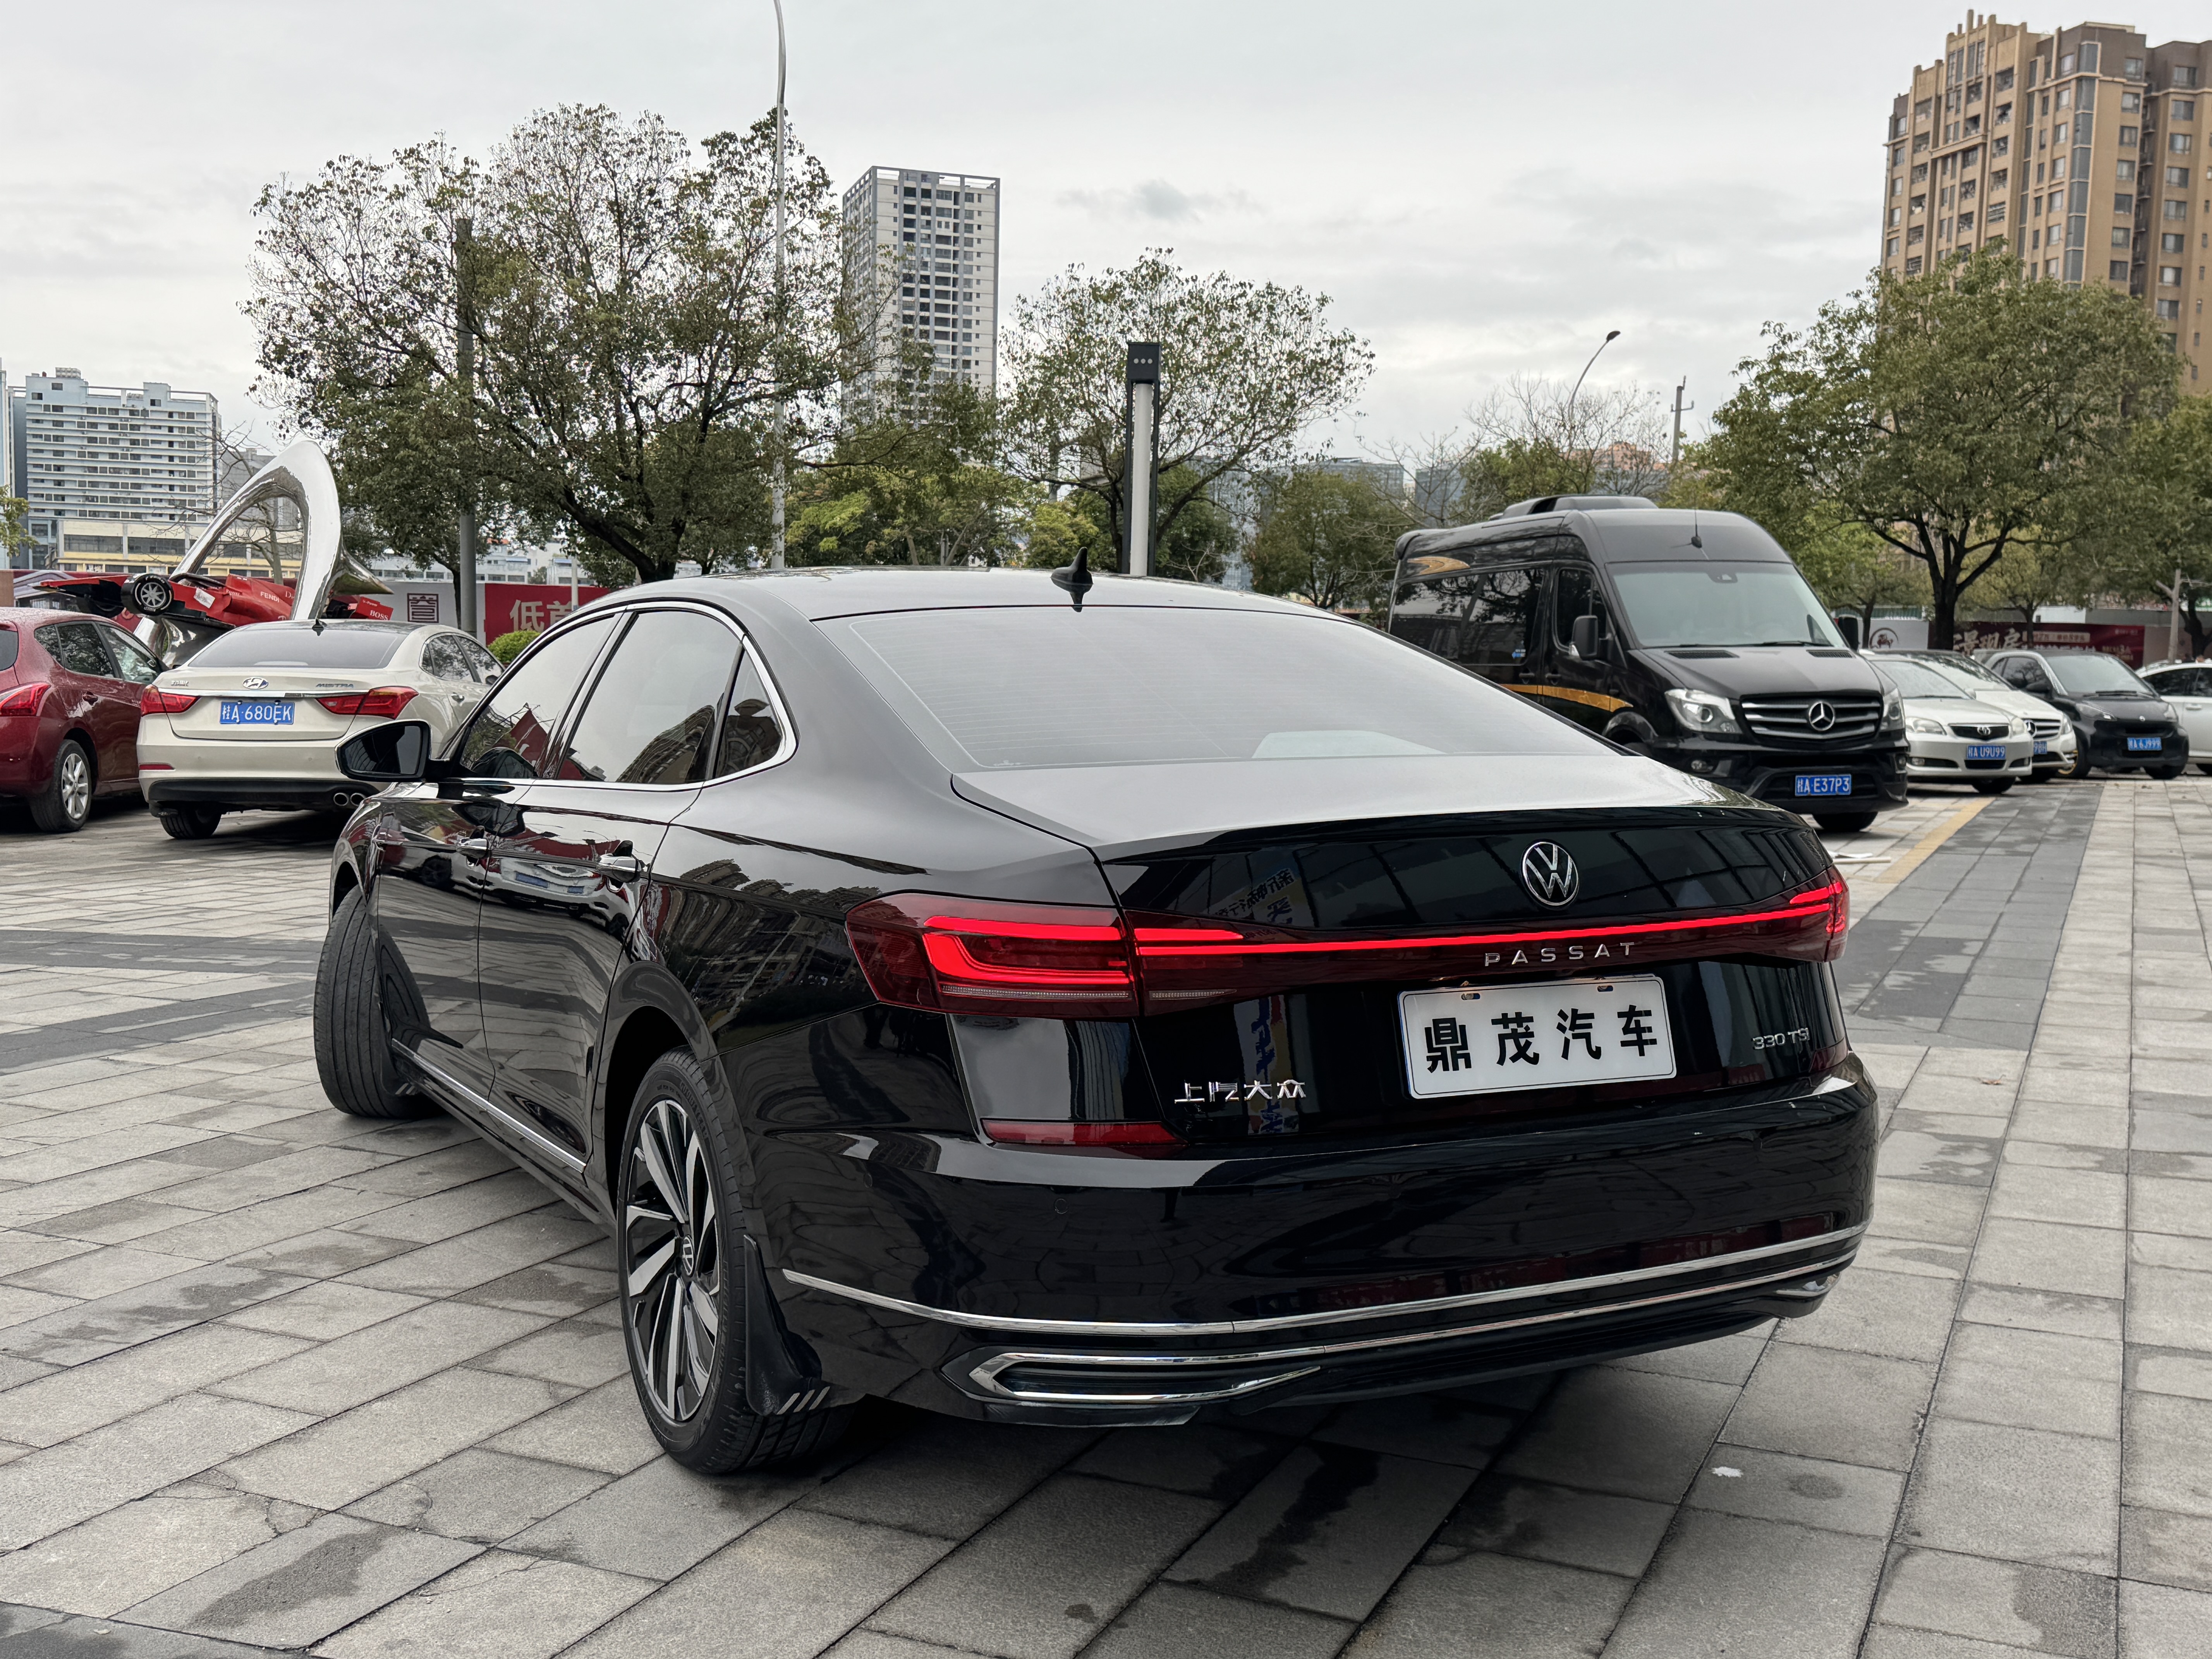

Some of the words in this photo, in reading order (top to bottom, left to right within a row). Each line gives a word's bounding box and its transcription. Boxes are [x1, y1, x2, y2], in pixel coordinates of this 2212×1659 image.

[370, 610, 388, 621] BOSS
[1485, 942, 1635, 967] PASSAT
[1424, 1005, 1657, 1073] 鼎茂汽车
[1752, 1037, 1786, 1050] 330
